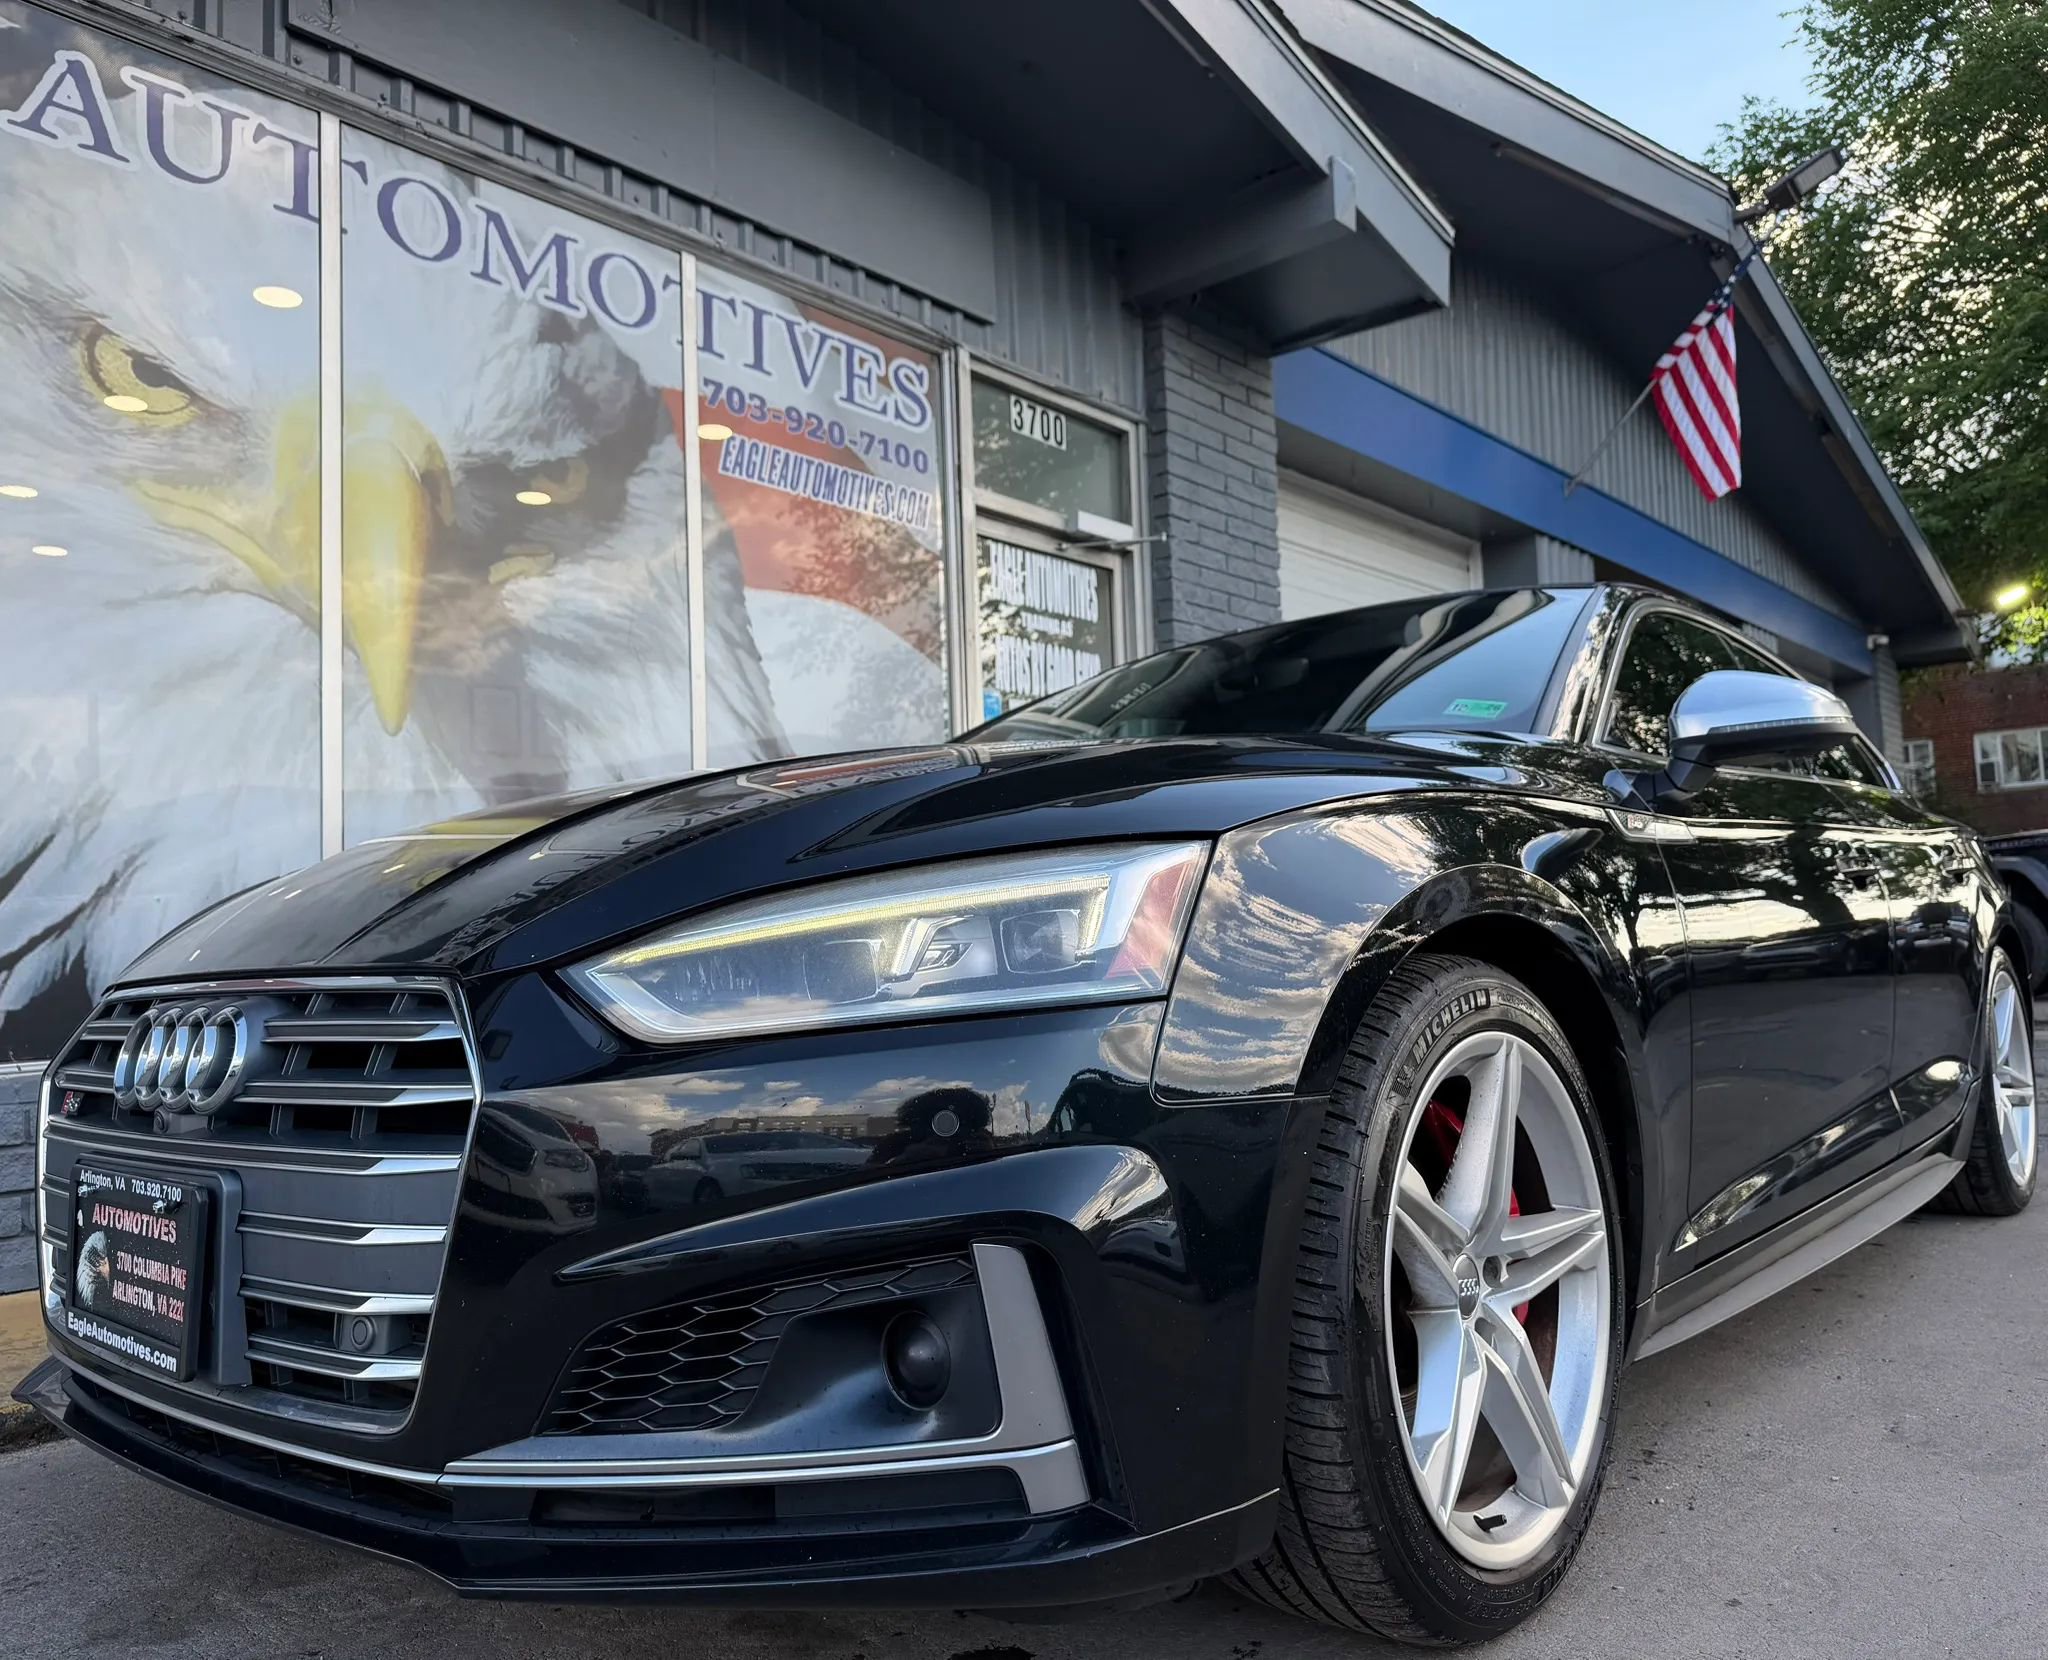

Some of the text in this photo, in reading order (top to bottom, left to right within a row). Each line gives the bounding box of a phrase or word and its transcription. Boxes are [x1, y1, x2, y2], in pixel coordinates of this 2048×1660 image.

[6, 52, 930, 427] AUTOMOTIVES
[703, 377, 929, 474] 703-920-7100
[1013, 399, 1063, 446] 3700
[720, 436, 930, 527] EAGLEAUTOMOTIVES.COM
[1413, 990, 1488, 1065] MICHELIN
[80, 1169, 182, 1202] Arlington, VA 703.920.7100
[92, 1203, 177, 1244] AUTOMOTIVES
[116, 1251, 187, 1290] 3700 COLUMBIA PIKE
[112, 1280, 155, 1316] ARLINGTON,
[157, 1293, 168, 1316] VA
[68, 1311, 177, 1372] EagleAutomotives.com
